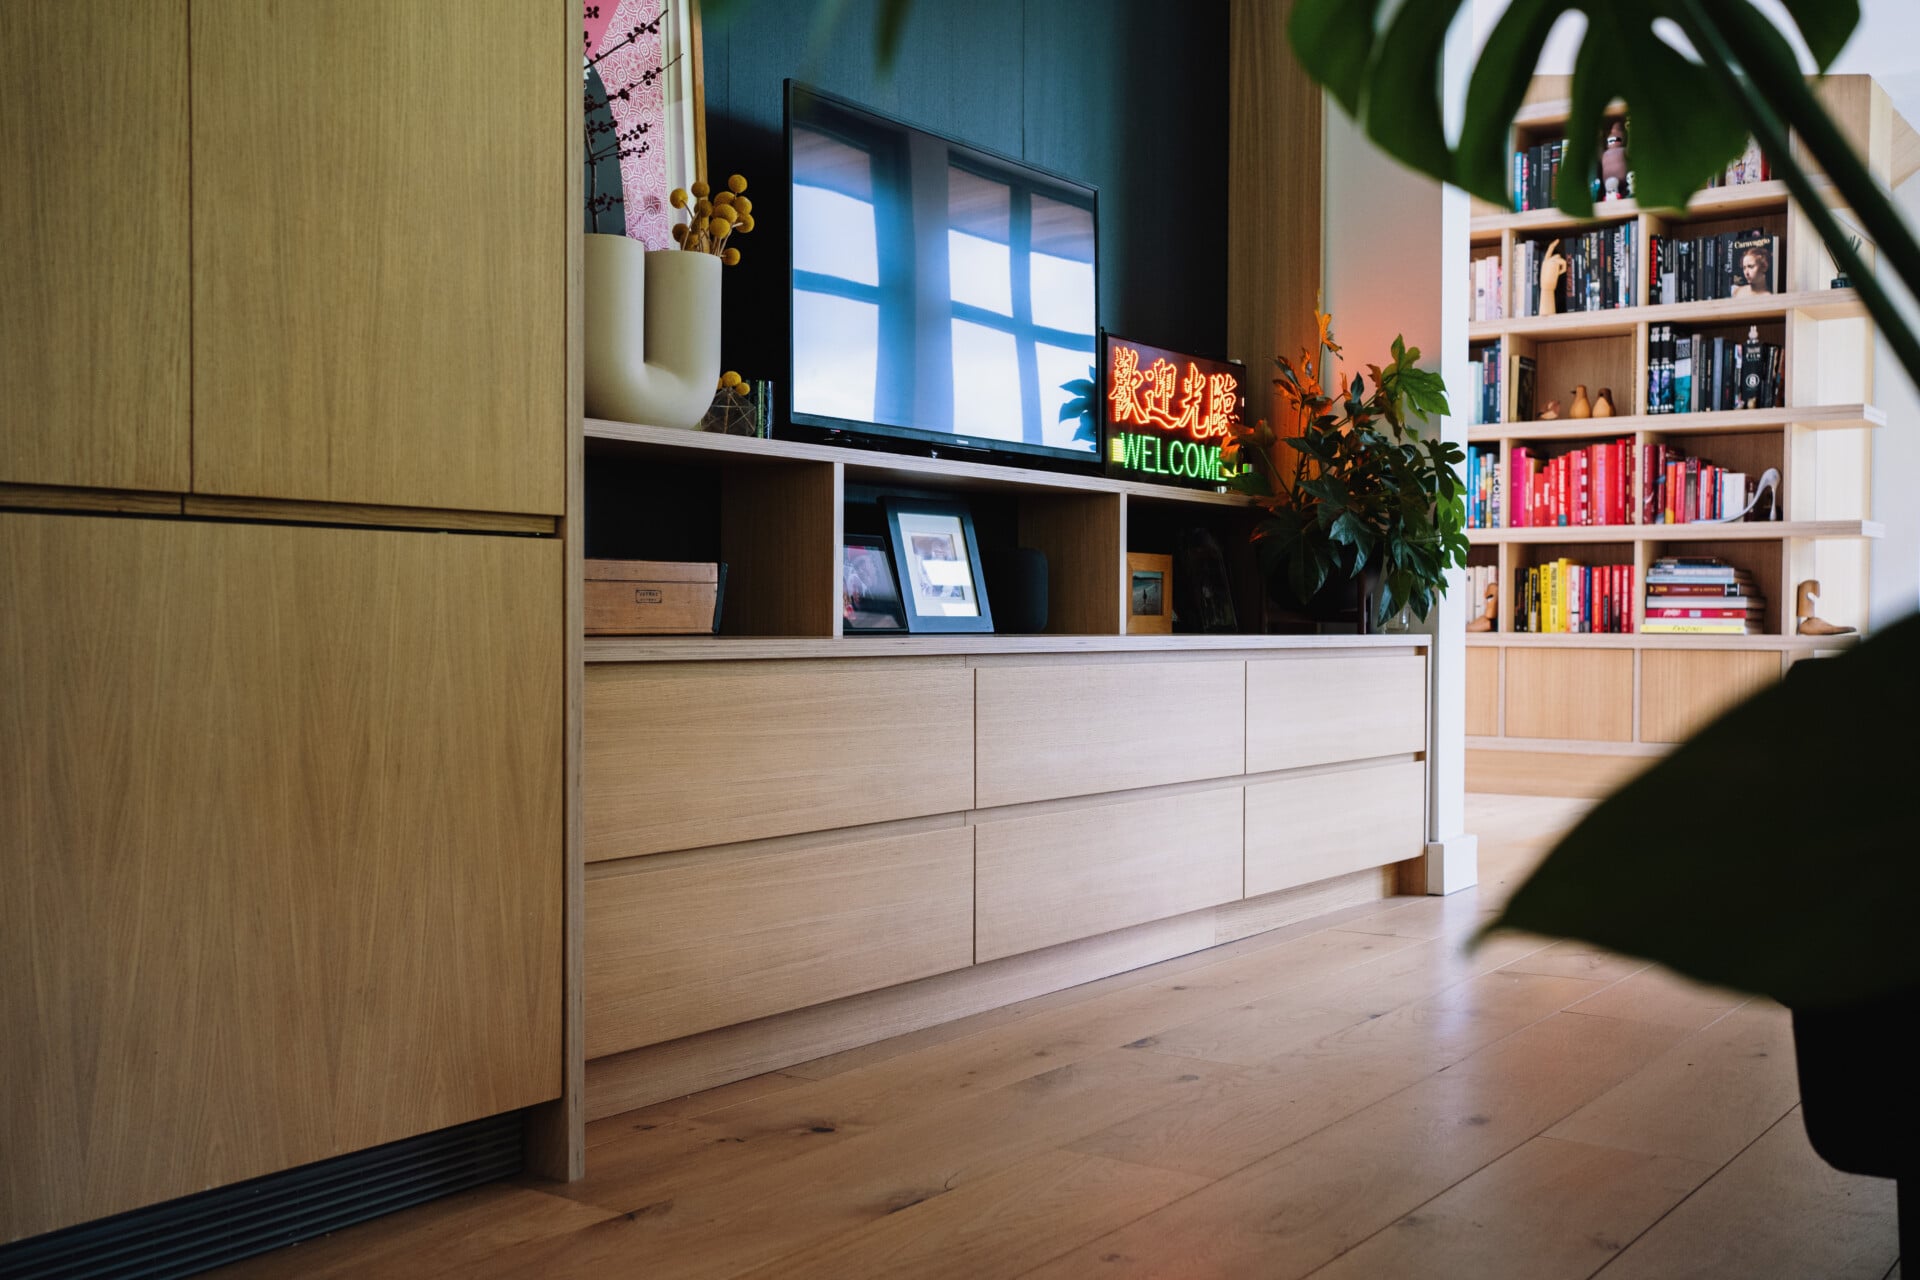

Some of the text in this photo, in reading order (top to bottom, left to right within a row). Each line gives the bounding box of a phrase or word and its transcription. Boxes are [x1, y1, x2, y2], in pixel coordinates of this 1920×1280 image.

[1734, 238, 1771, 249] Caravaggio
[1109, 346, 1239, 438] 歡迎光臨
[1120, 433, 1227, 481] WELCOME
